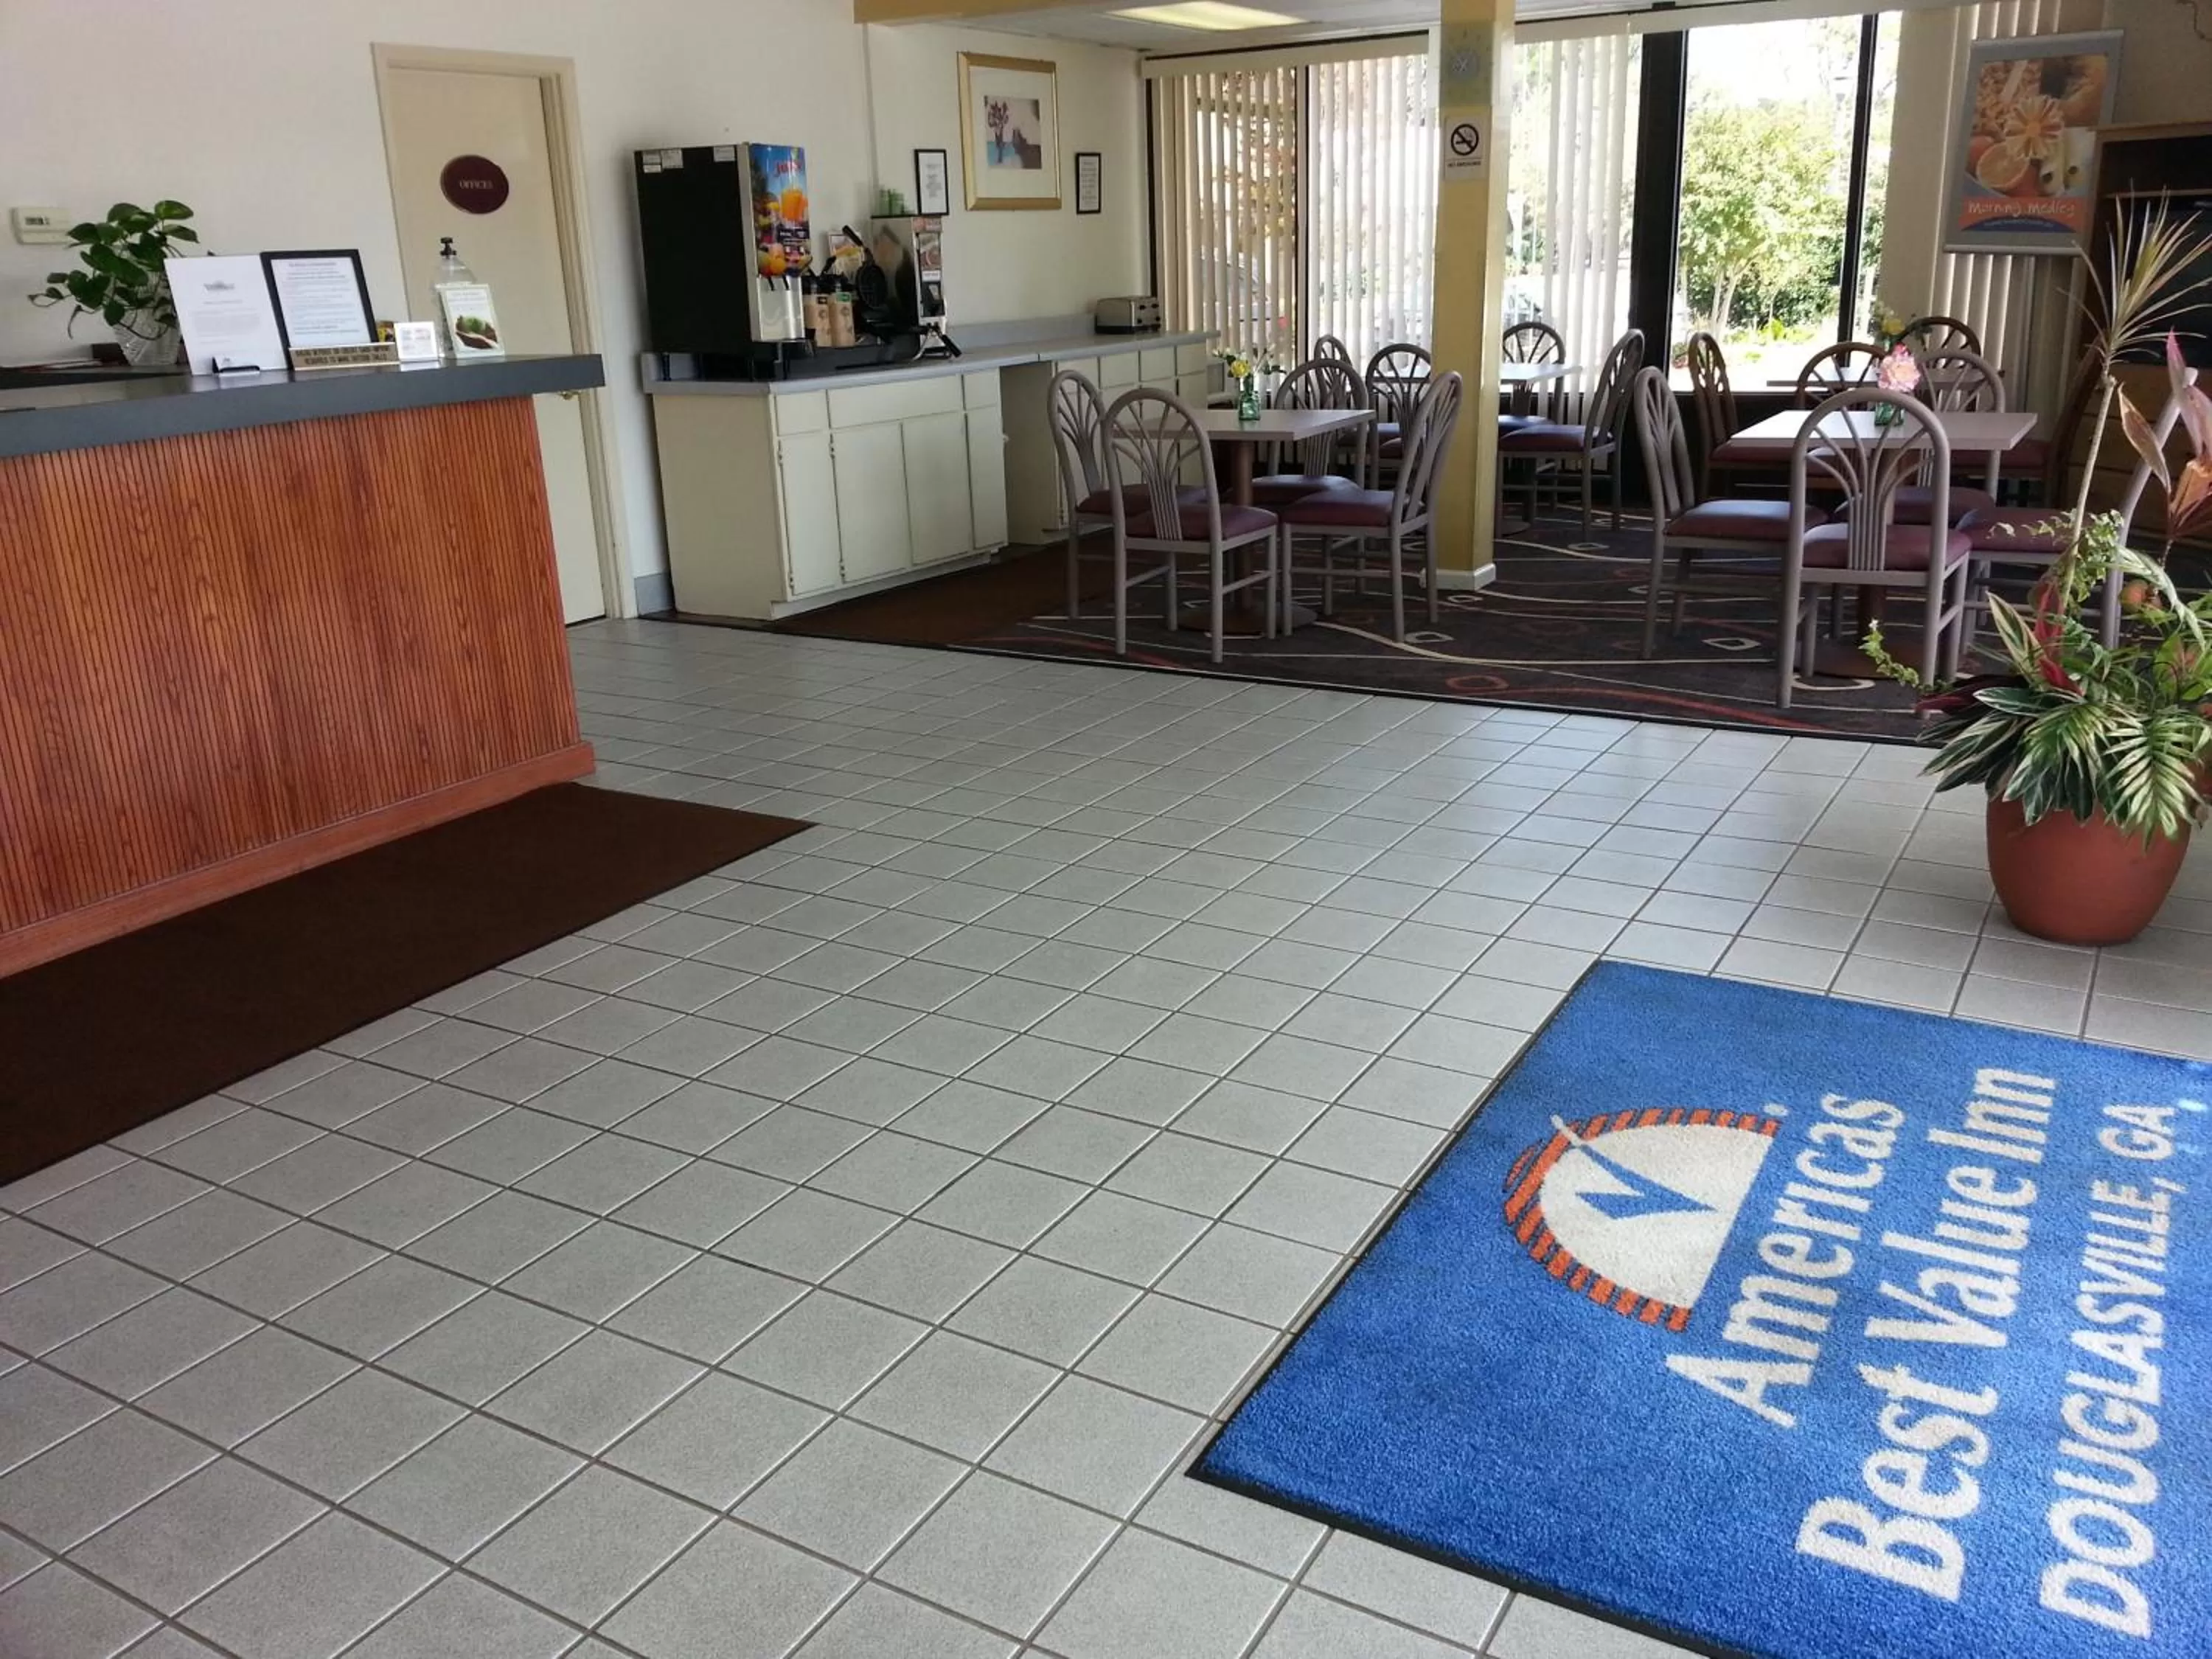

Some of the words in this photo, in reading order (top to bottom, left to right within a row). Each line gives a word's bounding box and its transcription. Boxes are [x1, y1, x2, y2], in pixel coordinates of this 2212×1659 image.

[1968, 200, 2021, 218] Morning
[1927, 1067, 2056, 1164] Inn
[2097, 1104, 2177, 1161] GA
[1666, 1092, 1906, 1428] Americas
[1865, 1166, 2038, 1349] Value
[1795, 1363, 2000, 1603] Best
[2039, 1178, 2190, 1639] DOUGLASVILLE,
